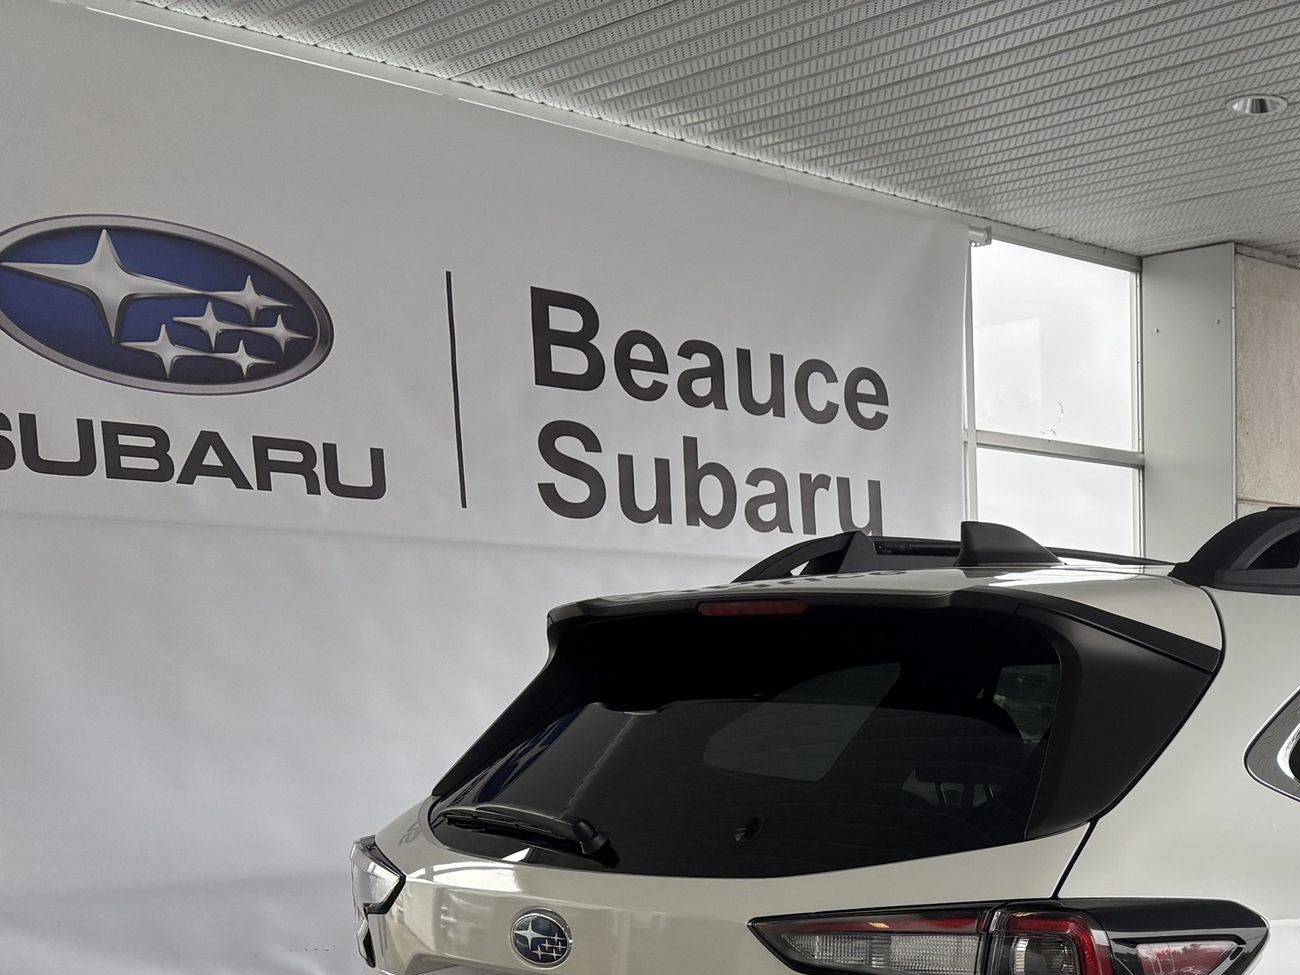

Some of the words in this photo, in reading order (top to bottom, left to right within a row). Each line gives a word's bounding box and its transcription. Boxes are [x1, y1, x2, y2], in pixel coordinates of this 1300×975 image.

[530, 286, 889, 430] Beauce
[0, 412, 387, 500] UBARU
[537, 420, 884, 537] Subaru
